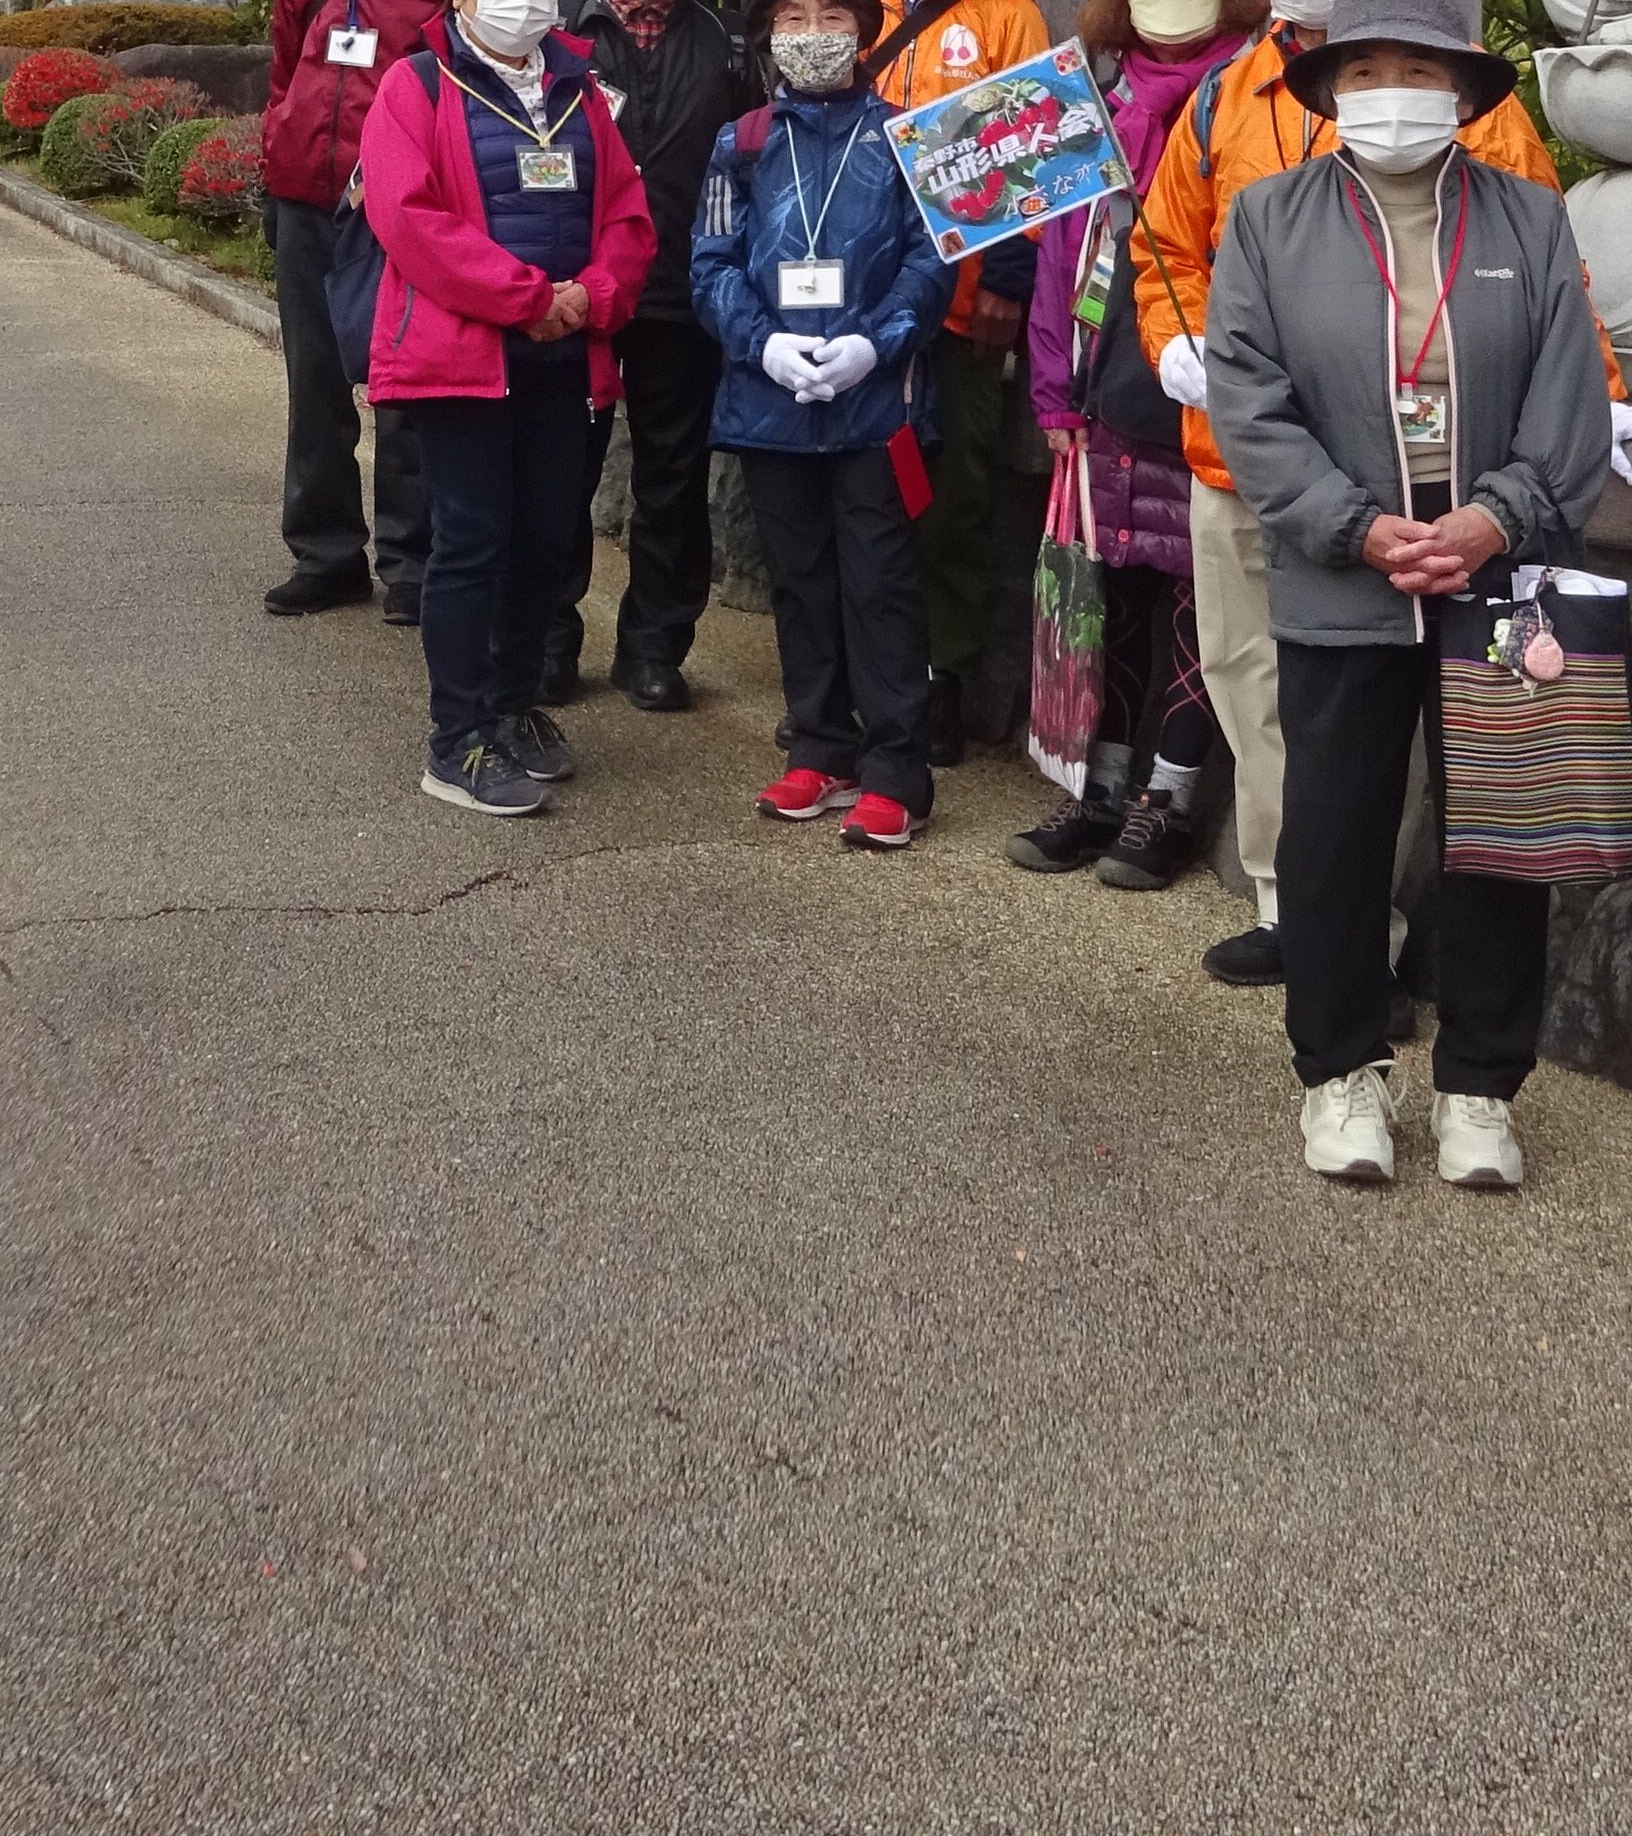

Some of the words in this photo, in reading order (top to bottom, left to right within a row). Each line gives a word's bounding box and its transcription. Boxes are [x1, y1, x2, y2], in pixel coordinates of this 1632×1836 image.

[914, 136, 979, 173] 秦野市
[928, 106, 1095, 195] 山形県人会
